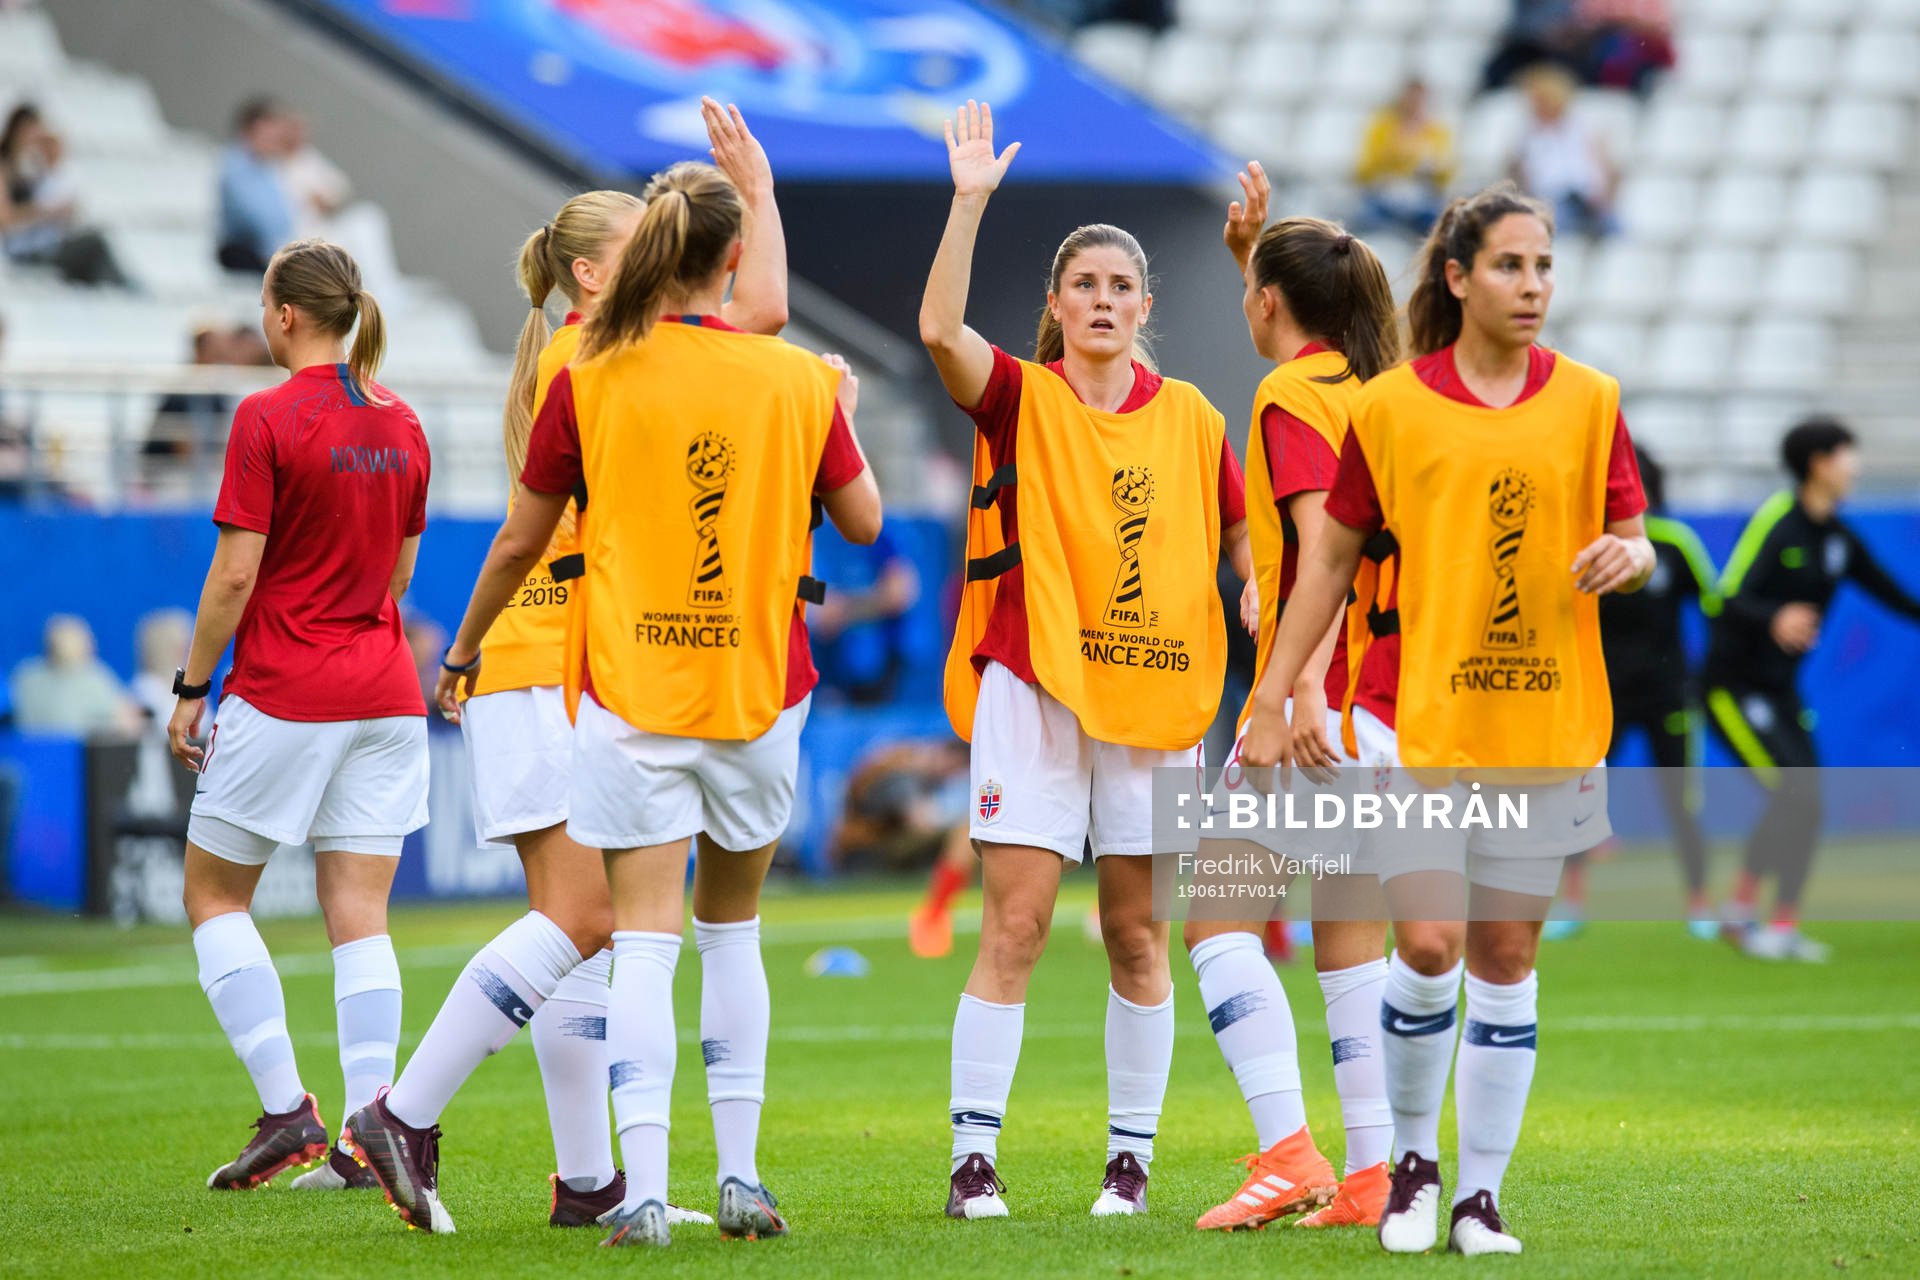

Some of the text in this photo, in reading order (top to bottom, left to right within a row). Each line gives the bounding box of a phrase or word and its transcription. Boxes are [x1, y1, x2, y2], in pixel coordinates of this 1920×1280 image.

[331, 446, 408, 475] NORWAY
[521, 586, 568, 607] 2019
[694, 590, 723, 602] FIFA
[643, 611, 700, 624] WOMEN'S
[1110, 609, 1140, 623] FIFA
[636, 623, 725, 649] FRANCE
[1119, 633, 1160, 646] WORLD
[1163, 638, 1184, 649] CUP
[1488, 632, 1518, 644] FIFA
[1081, 641, 1190, 672] ANCE 2019
[1497, 657, 1541, 667] WORLD
